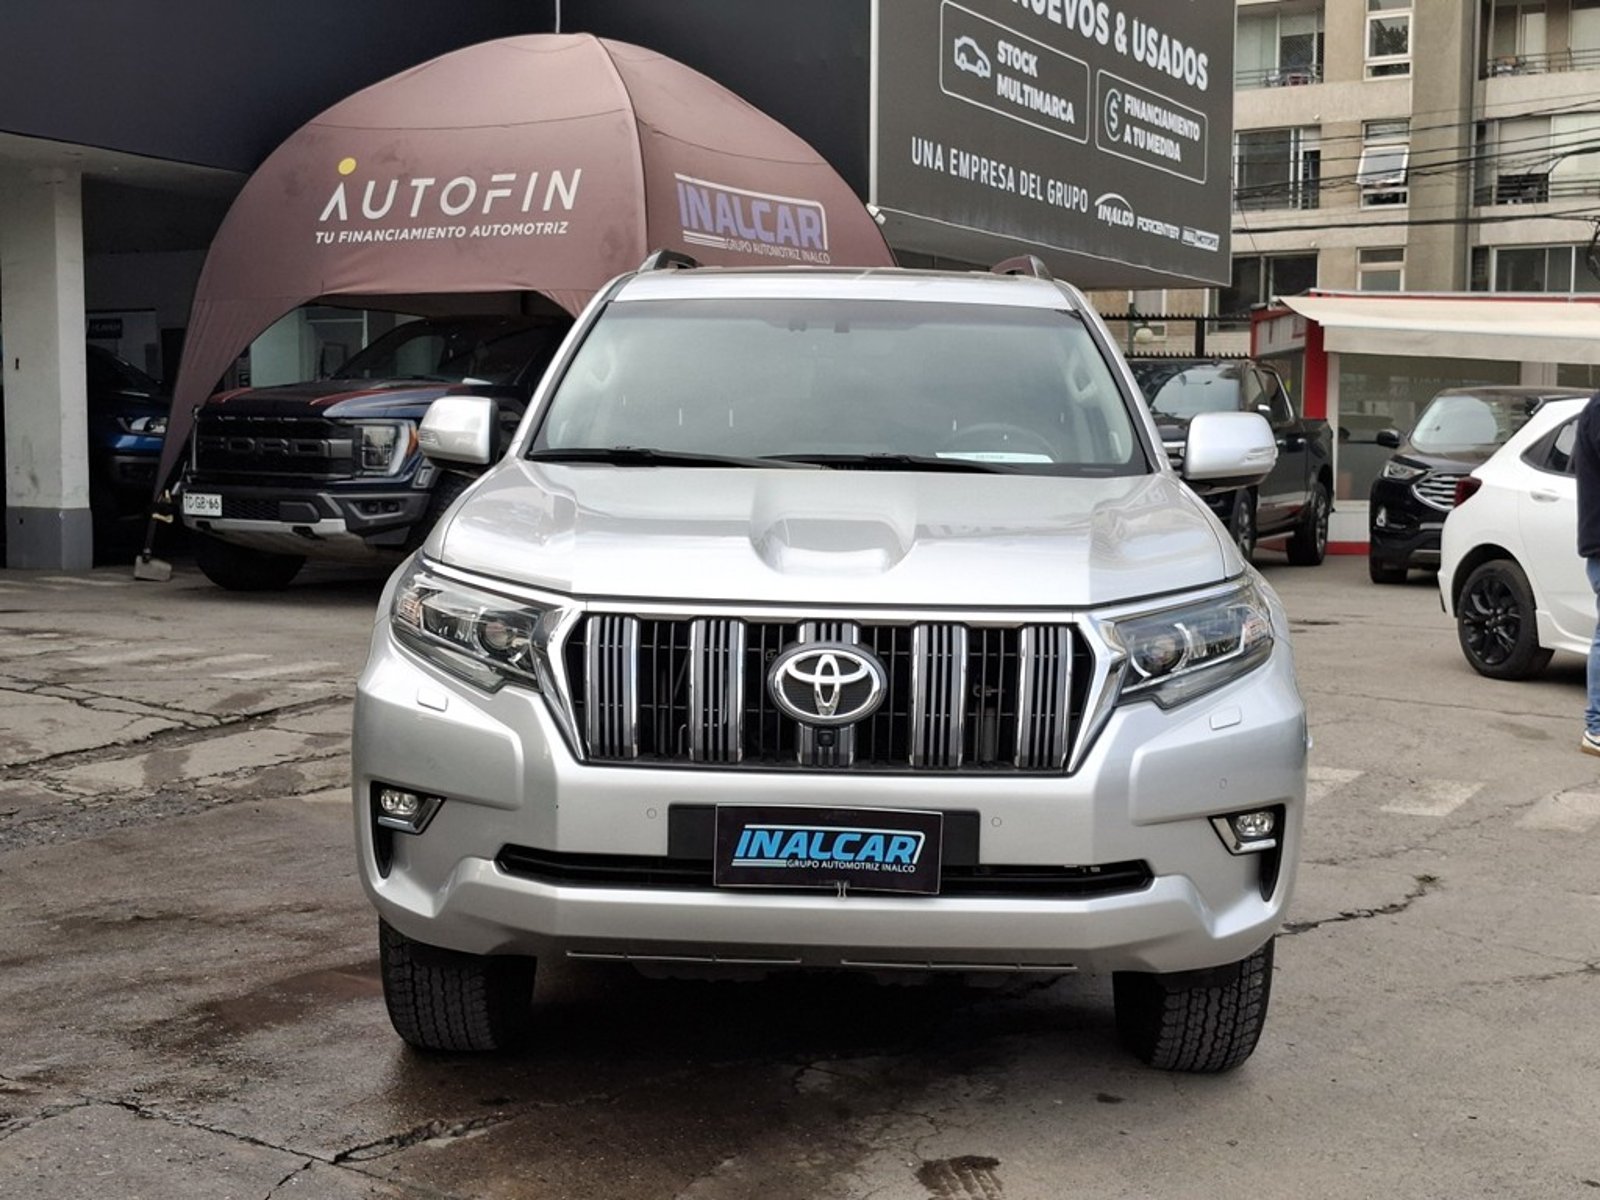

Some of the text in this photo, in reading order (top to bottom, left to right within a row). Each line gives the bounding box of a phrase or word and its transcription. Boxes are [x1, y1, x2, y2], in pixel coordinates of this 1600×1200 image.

[997, 40, 1038, 78] STOCK
[1114, 12, 1127, 55] &
[1132, 19, 1208, 91] USADOS
[997, 73, 1075, 124] MULTIMARCA
[1124, 93, 1200, 141] FINANCIAMIENTO
[1123, 124, 1181, 162] A TU MEDIDA
[319, 168, 582, 222] AUTOFIN
[912, 136, 944, 172] UNA
[950, 147, 1015, 193] EMPRESA
[1019, 169, 1043, 201] DEL
[1047, 179, 1088, 213] GRUPO
[315, 221, 568, 244] TU FINANCIAMIENTO AUTOMOTRIZ
[676, 182, 823, 249] INALCAR
[727, 239, 831, 264] GRUPO AUTOMOTRIZ INALCO
[734, 830, 916, 863] INALCAR
[786, 859, 916, 873] GRUPO AUTOMOTRIZ INALCO
